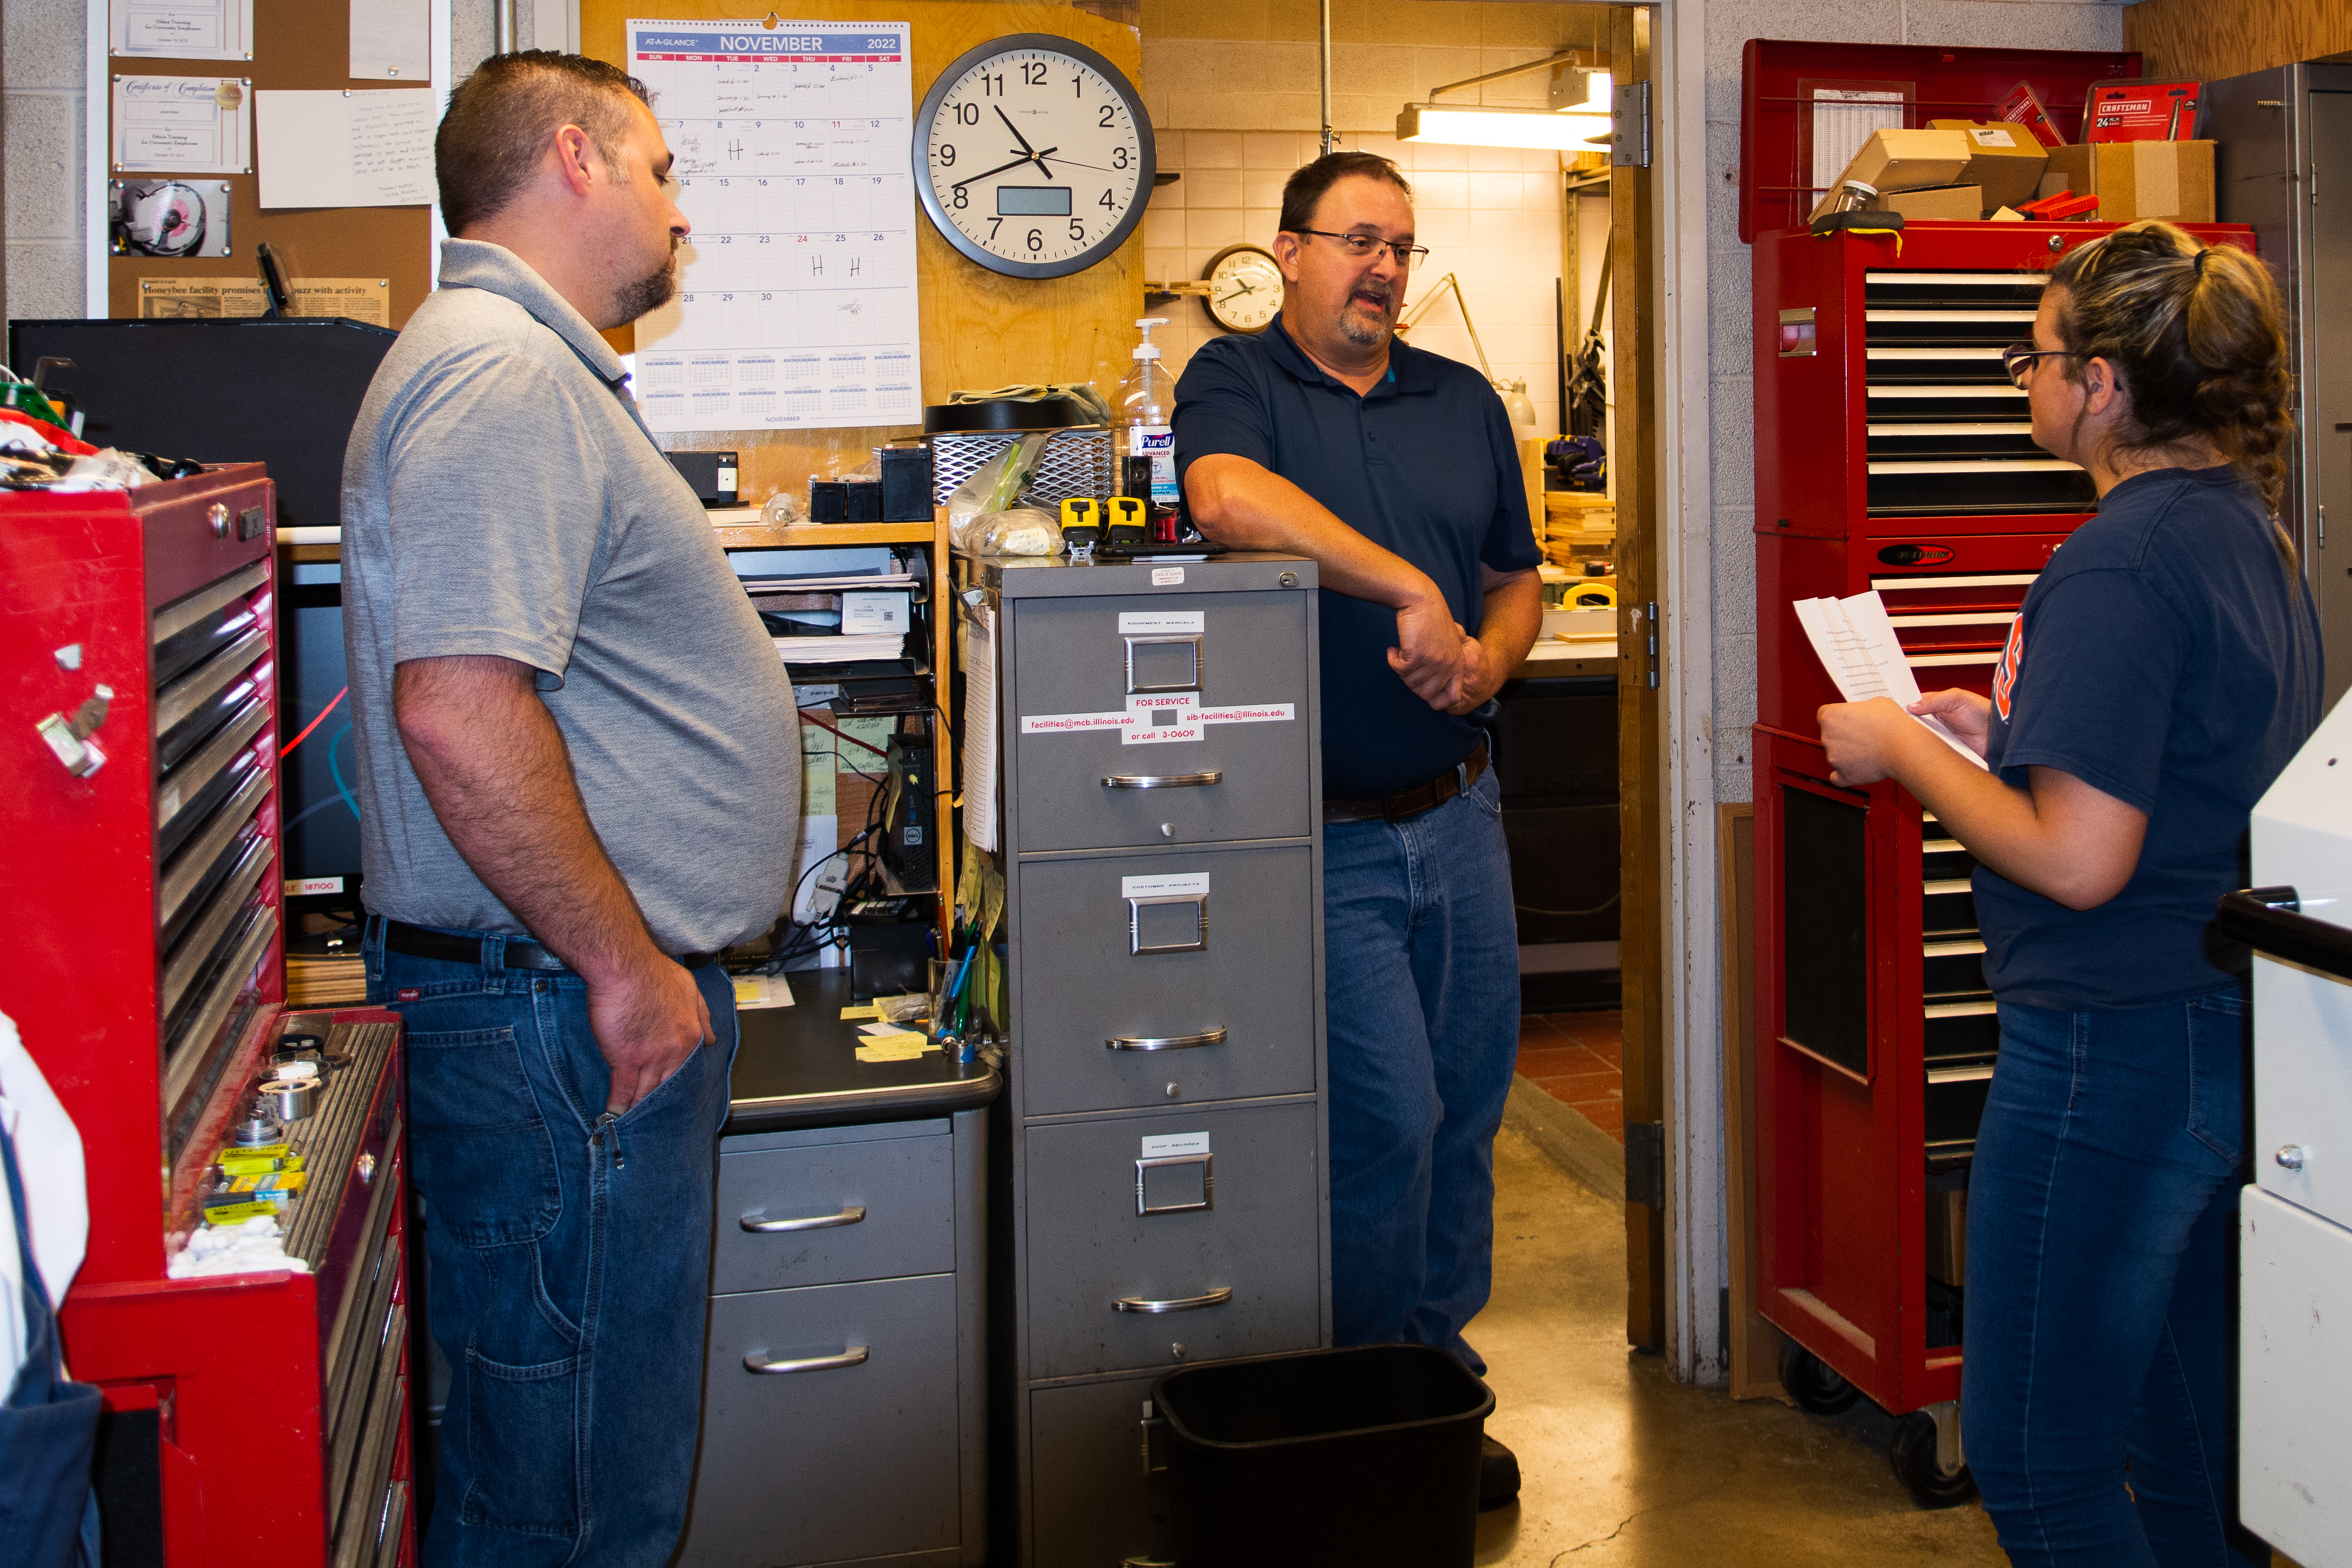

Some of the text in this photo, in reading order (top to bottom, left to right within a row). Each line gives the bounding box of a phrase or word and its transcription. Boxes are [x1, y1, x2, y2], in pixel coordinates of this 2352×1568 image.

[720, 36, 823, 51] NOVEMBER
[867, 38, 896, 49] 2022
[1020, 62, 1047, 85] 12
[981, 73, 1003, 97] 11
[1072, 75, 1081, 98] 1
[953, 103, 979, 126] 10
[1099, 105, 1115, 128] 2
[2101, 103, 2147, 113] CRAFTSMAN
[2096, 117, 2109, 128] 24
[727, 139, 744, 161] H
[940, 144, 956, 167] 9
[1113, 147, 1128, 170] 3
[953, 186, 969, 209] 8
[1099, 188, 1115, 211] 4
[987, 217, 1003, 240] 7
[1069, 218, 1085, 241] 5
[1027, 229, 1043, 251] 6
[812, 255, 860, 277] H H
[1242, 256, 1251, 264] 12
[1218, 271, 1227, 279] 10
[144, 286, 187, 295] Honeybee
[189, 286, 219, 295] facility
[222, 286, 261, 295] promises
[335, 286, 366, 295] activity
[1273, 285, 1280, 293] 3
[1220, 301, 1226, 309] 8
[1259, 311, 1267, 319] 5
[1142, 436, 1171, 447] Purell
[1155, 697, 1190, 706] SERVICE
[305, 882, 334, 891] 187100
